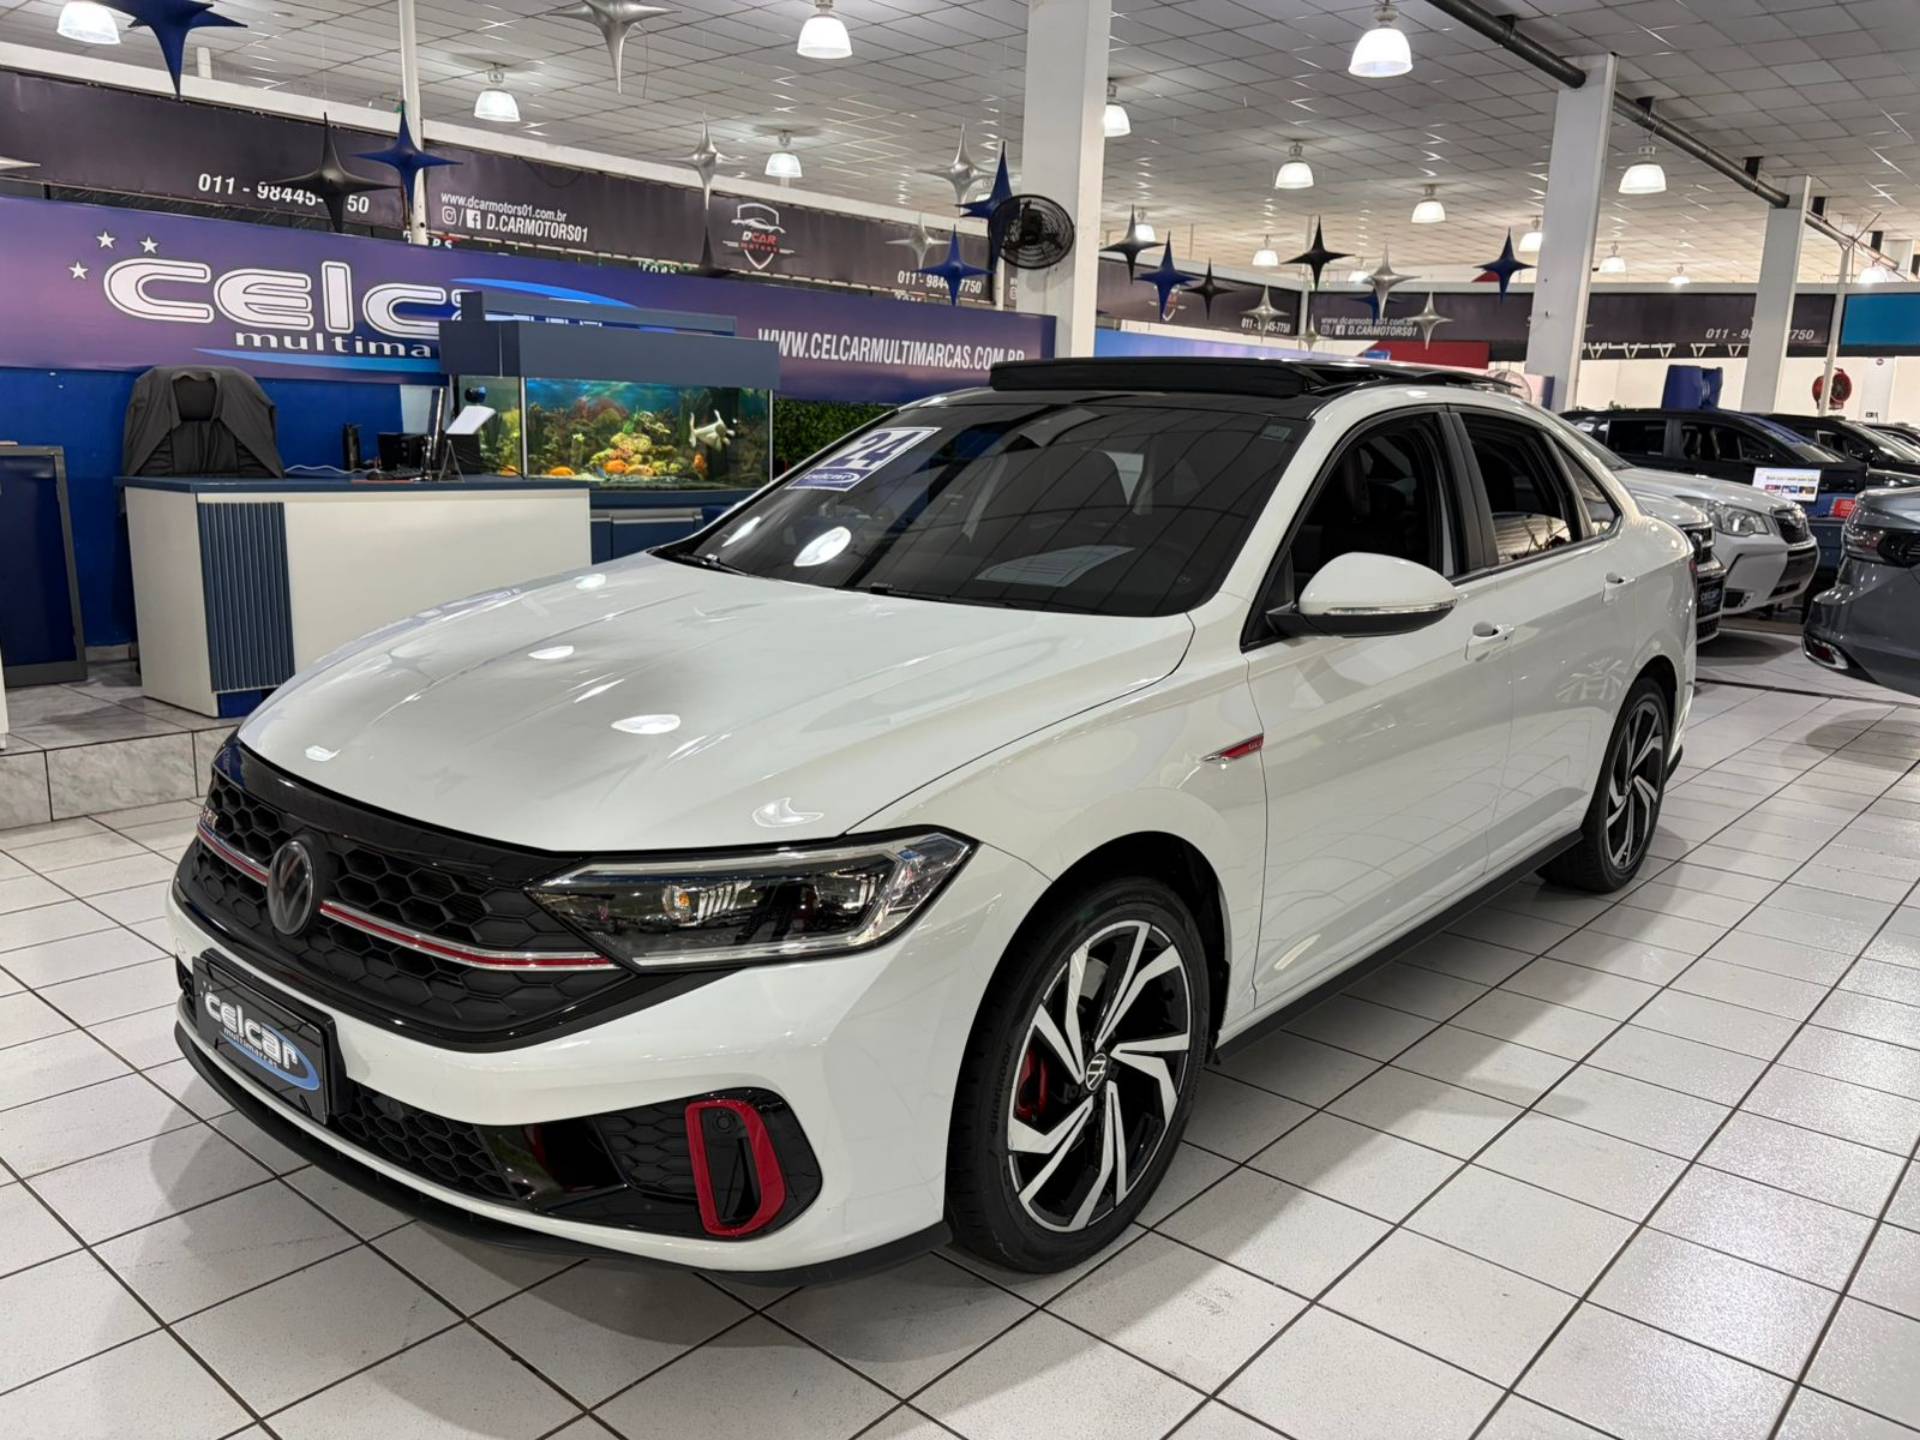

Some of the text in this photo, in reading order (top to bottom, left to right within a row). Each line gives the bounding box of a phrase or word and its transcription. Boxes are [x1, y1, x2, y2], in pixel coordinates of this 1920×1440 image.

[198, 173, 235, 195] 011
[257, 181, 370, 214] 98445-50
[440, 192, 567, 222] www.dcarmotors01.com.br
[486, 213, 588, 243] D.CARMOTORS01
[103, 257, 475, 340] celc
[897, 270, 916, 285] 011
[926, 274, 982, 294] 9847750
[235, 331, 431, 358] multima
[757, 328, 1025, 371] WW.CELCARMULTIMARCAS.COM
[1705, 328, 1729, 339] 011
[822, 431, 923, 468] 24
[204, 991, 299, 1070] celcar
